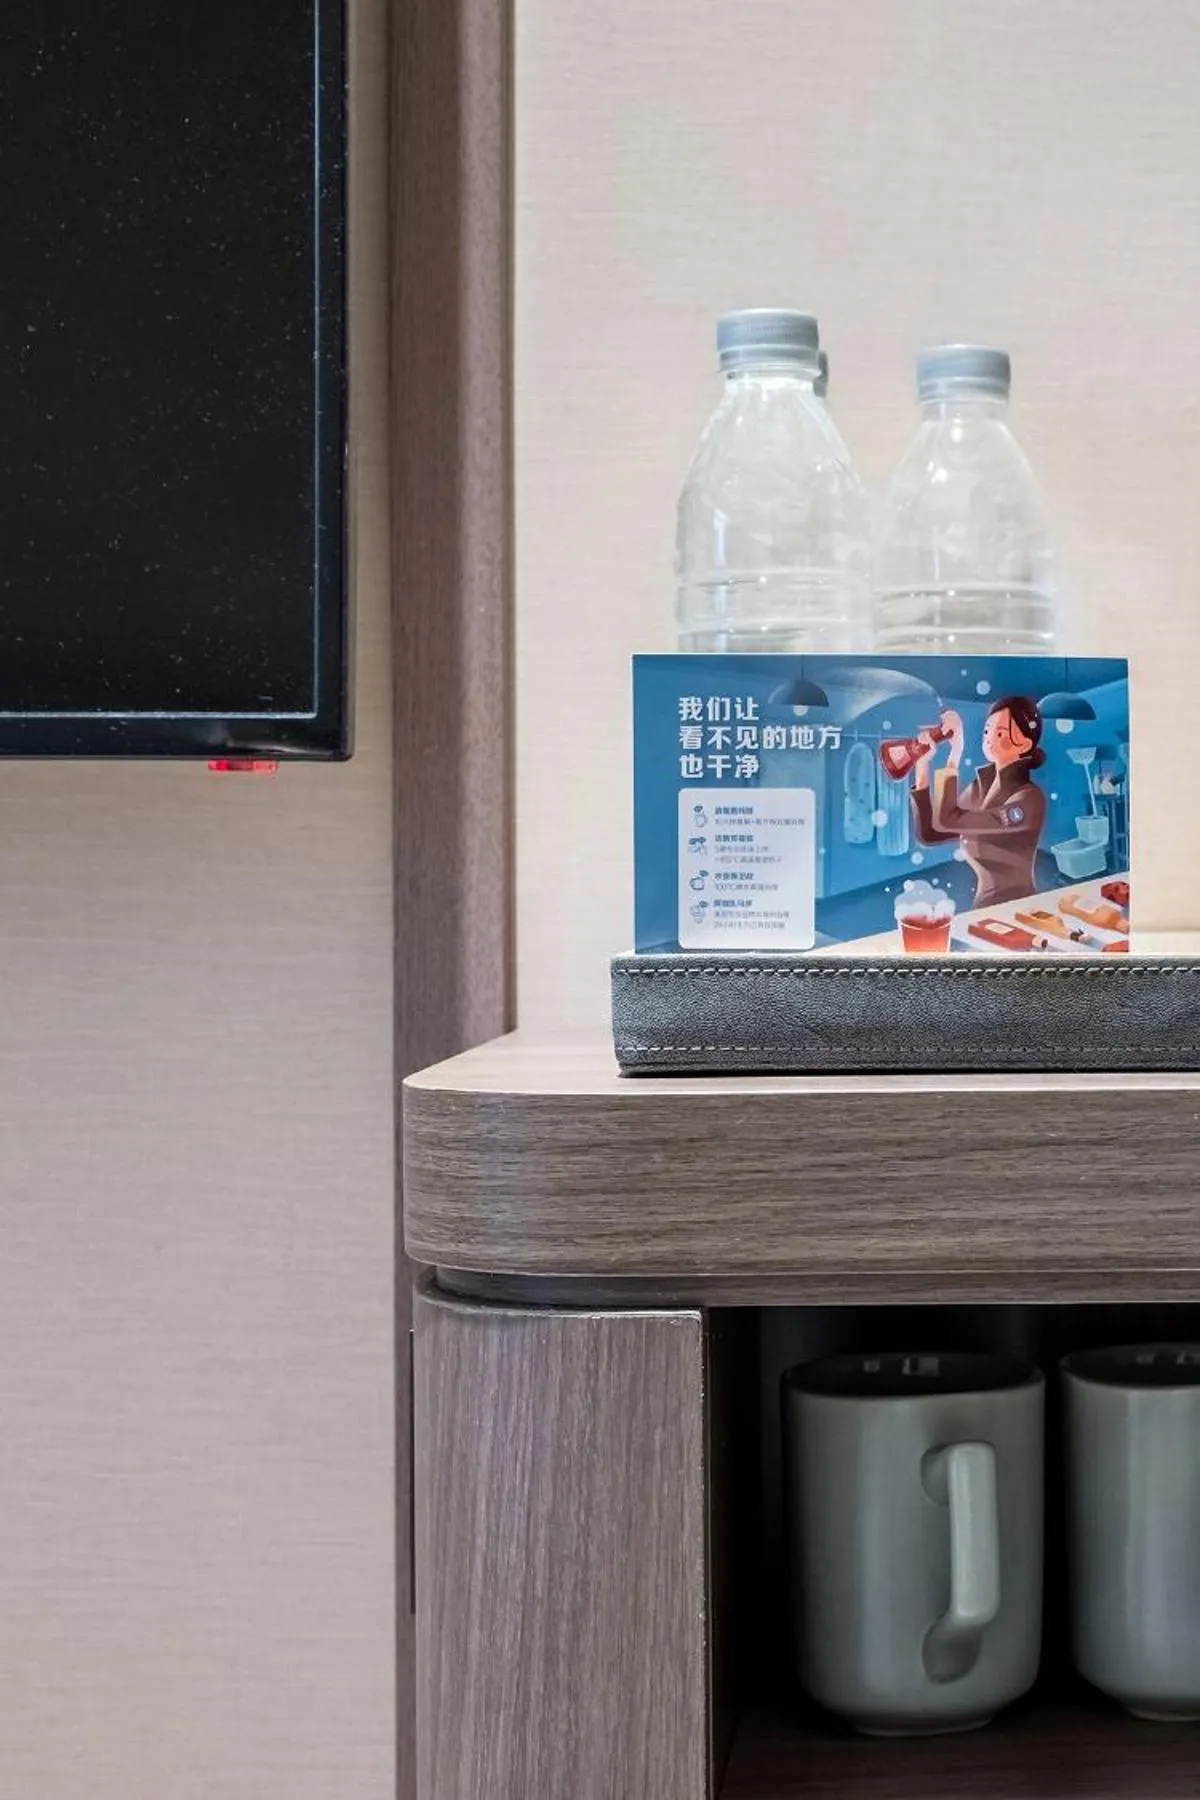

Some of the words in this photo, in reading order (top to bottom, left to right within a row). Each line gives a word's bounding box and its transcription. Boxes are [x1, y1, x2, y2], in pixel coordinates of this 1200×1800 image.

[678, 696, 759, 722] 我们让
[679, 725, 843, 750] 看不见的地方
[679, 754, 760, 779] 也干净
